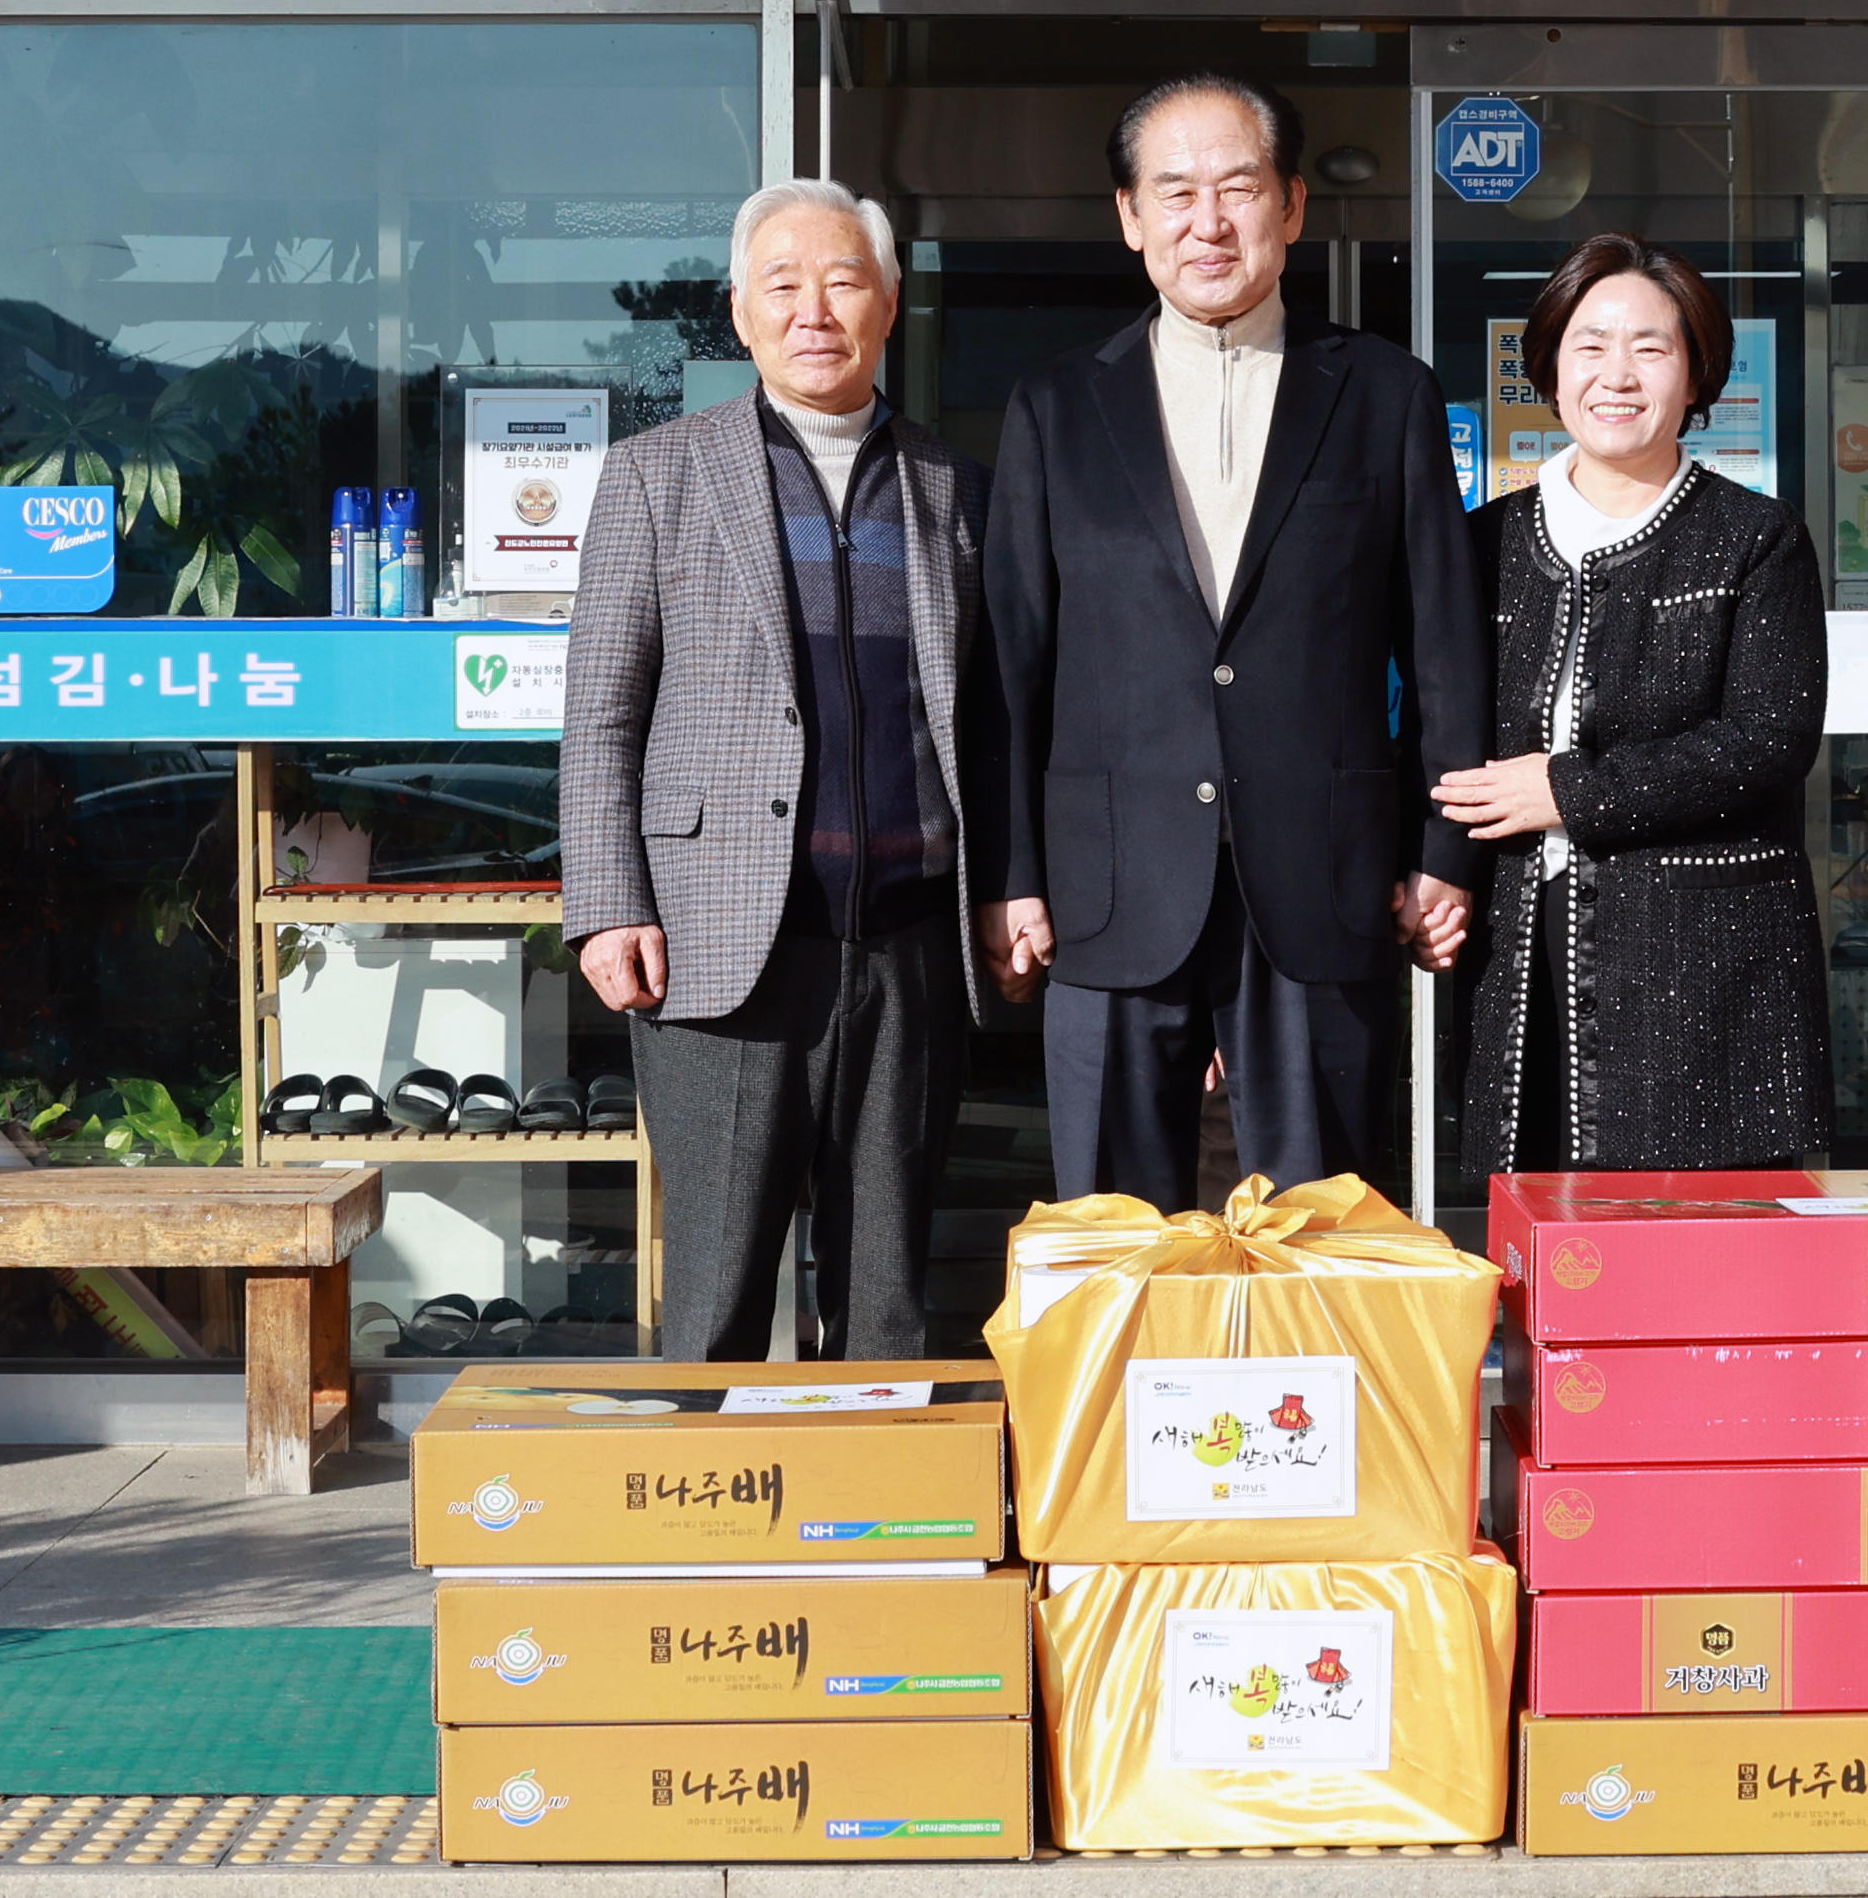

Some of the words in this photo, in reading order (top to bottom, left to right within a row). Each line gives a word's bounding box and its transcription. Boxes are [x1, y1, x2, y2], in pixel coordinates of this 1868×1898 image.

[1452, 131, 1524, 168] ADT
[1462, 178, 1514, 187] 1588-6400
[504, 456, 569, 469] 최우수기관
[22, 497, 105, 526] CESCO
[49, 527, 109, 554] Members
[1154, 1382, 1174, 1391] OK!
[1151, 1425, 1203, 1450] 새해
[1206, 1411, 1234, 1453] 복
[1236, 1444, 1327, 1472] 받으세요!
[1232, 1483, 1268, 1492] 전라남도
[447, 1502, 474, 1515] NA
[521, 1500, 544, 1514] JU
[655, 1463, 783, 1537] 나주배
[803, 1525, 834, 1538] NH
[1192, 1632, 1213, 1641] OK!
[1705, 1631, 1730, 1646] 명품
[469, 1655, 497, 1669] NA
[544, 1654, 567, 1668] JU
[680, 1616, 809, 1692] 나주배
[829, 1679, 859, 1692] NH
[1189, 1675, 1240, 1700] 새해
[1243, 1663, 1270, 1709] 복
[1664, 1664, 1770, 1694] 거창사과
[1272, 1699, 1363, 1724] 받으세요!
[1267, 1735, 1303, 1745] 전라남도
[472, 1796, 500, 1810] NA
[546, 1795, 570, 1809] JU
[682, 1760, 810, 1834] 나주배
[1560, 1791, 1588, 1805] NA
[1634, 1790, 1657, 1804] JU
[829, 1822, 860, 1836] NH
